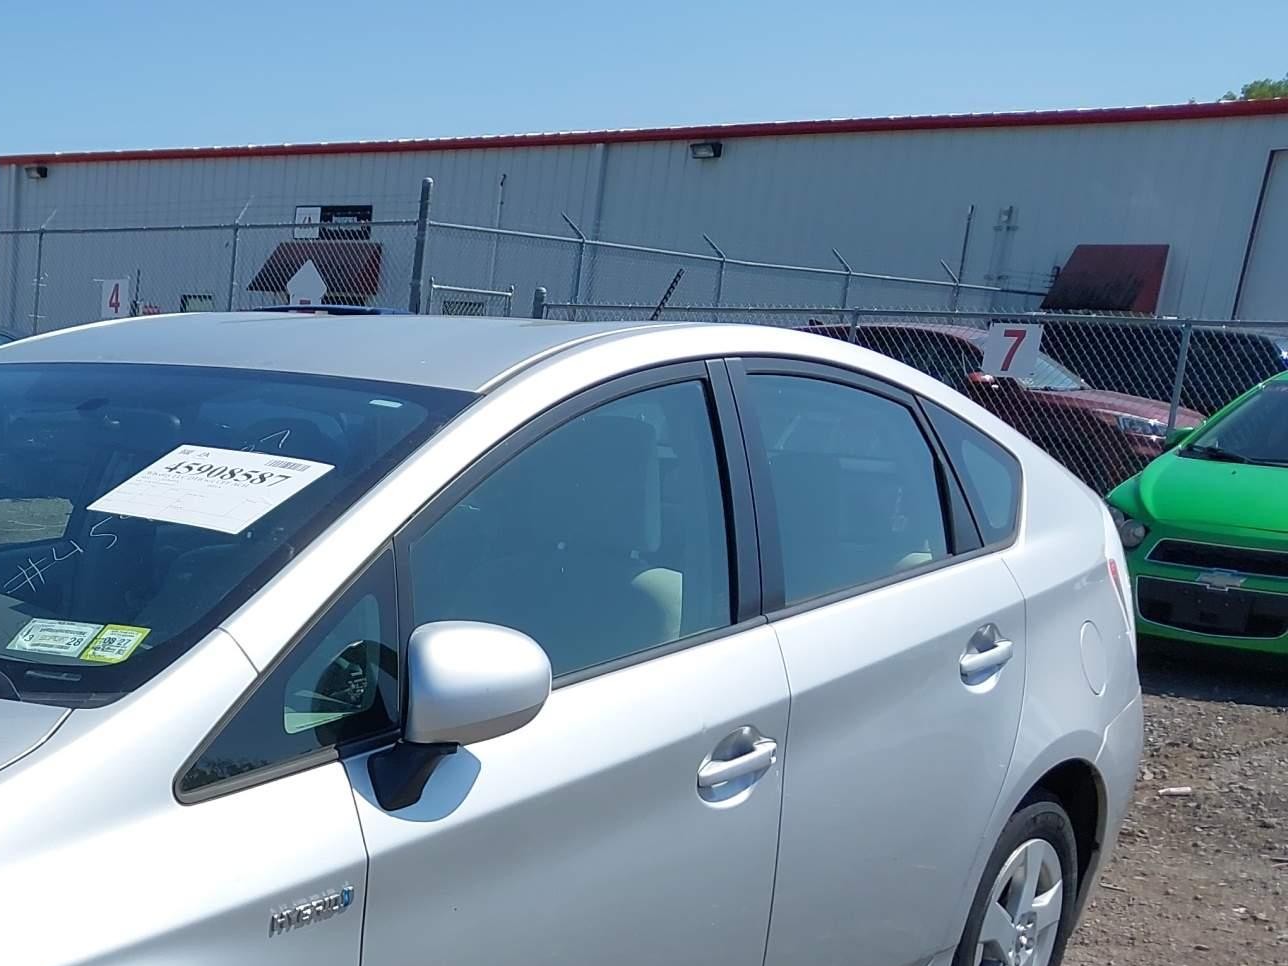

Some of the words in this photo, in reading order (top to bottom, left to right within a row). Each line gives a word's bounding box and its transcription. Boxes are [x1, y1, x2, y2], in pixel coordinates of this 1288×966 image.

[108, 283, 121, 314] 4
[1000, 329, 1027, 371] 7
[163, 460, 293, 488] 45908587
[65, 637, 84, 647] 28
[269, 886, 354, 938] HYBRID
